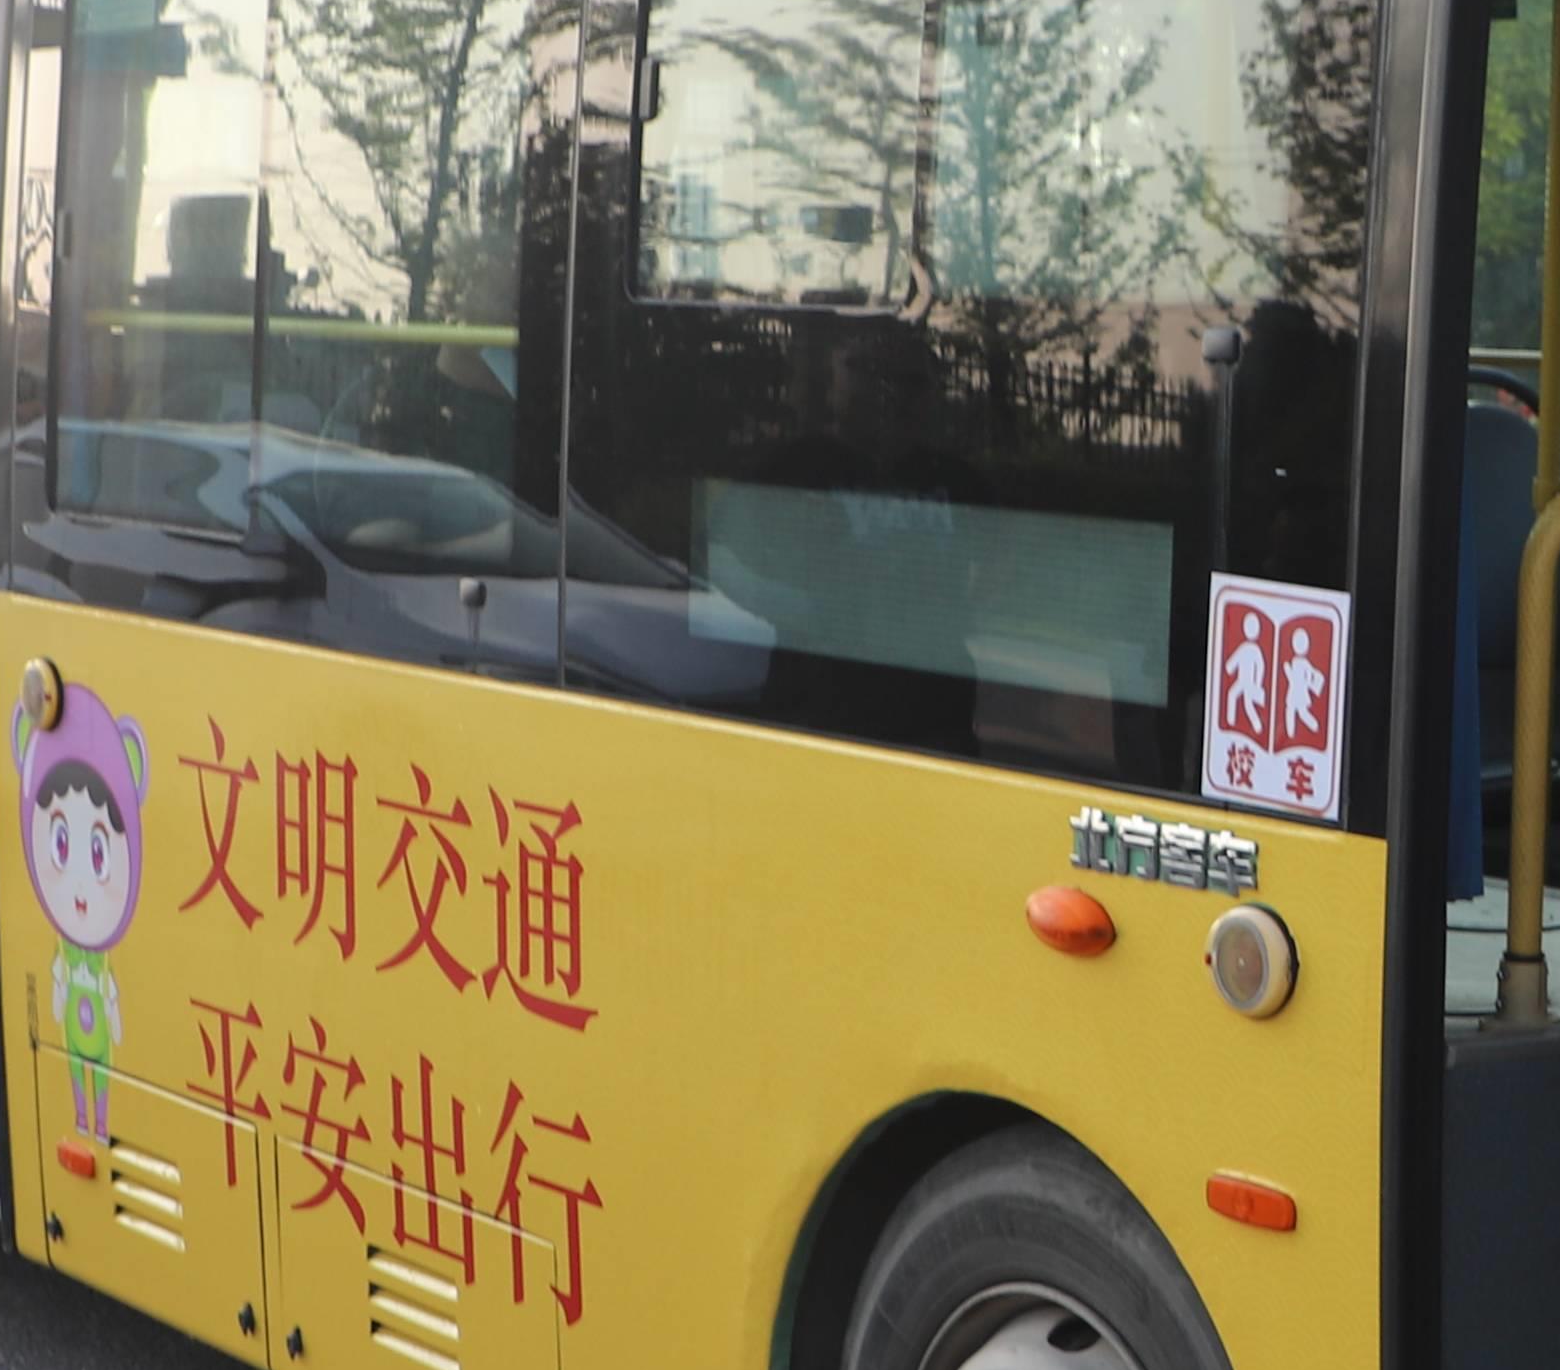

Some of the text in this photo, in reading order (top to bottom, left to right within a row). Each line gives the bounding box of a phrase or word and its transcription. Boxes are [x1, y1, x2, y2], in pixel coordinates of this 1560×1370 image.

[177, 713, 600, 1031] 文明交通
[1226, 743, 1315, 800] 校车
[185, 997, 604, 1327] 平安出行
